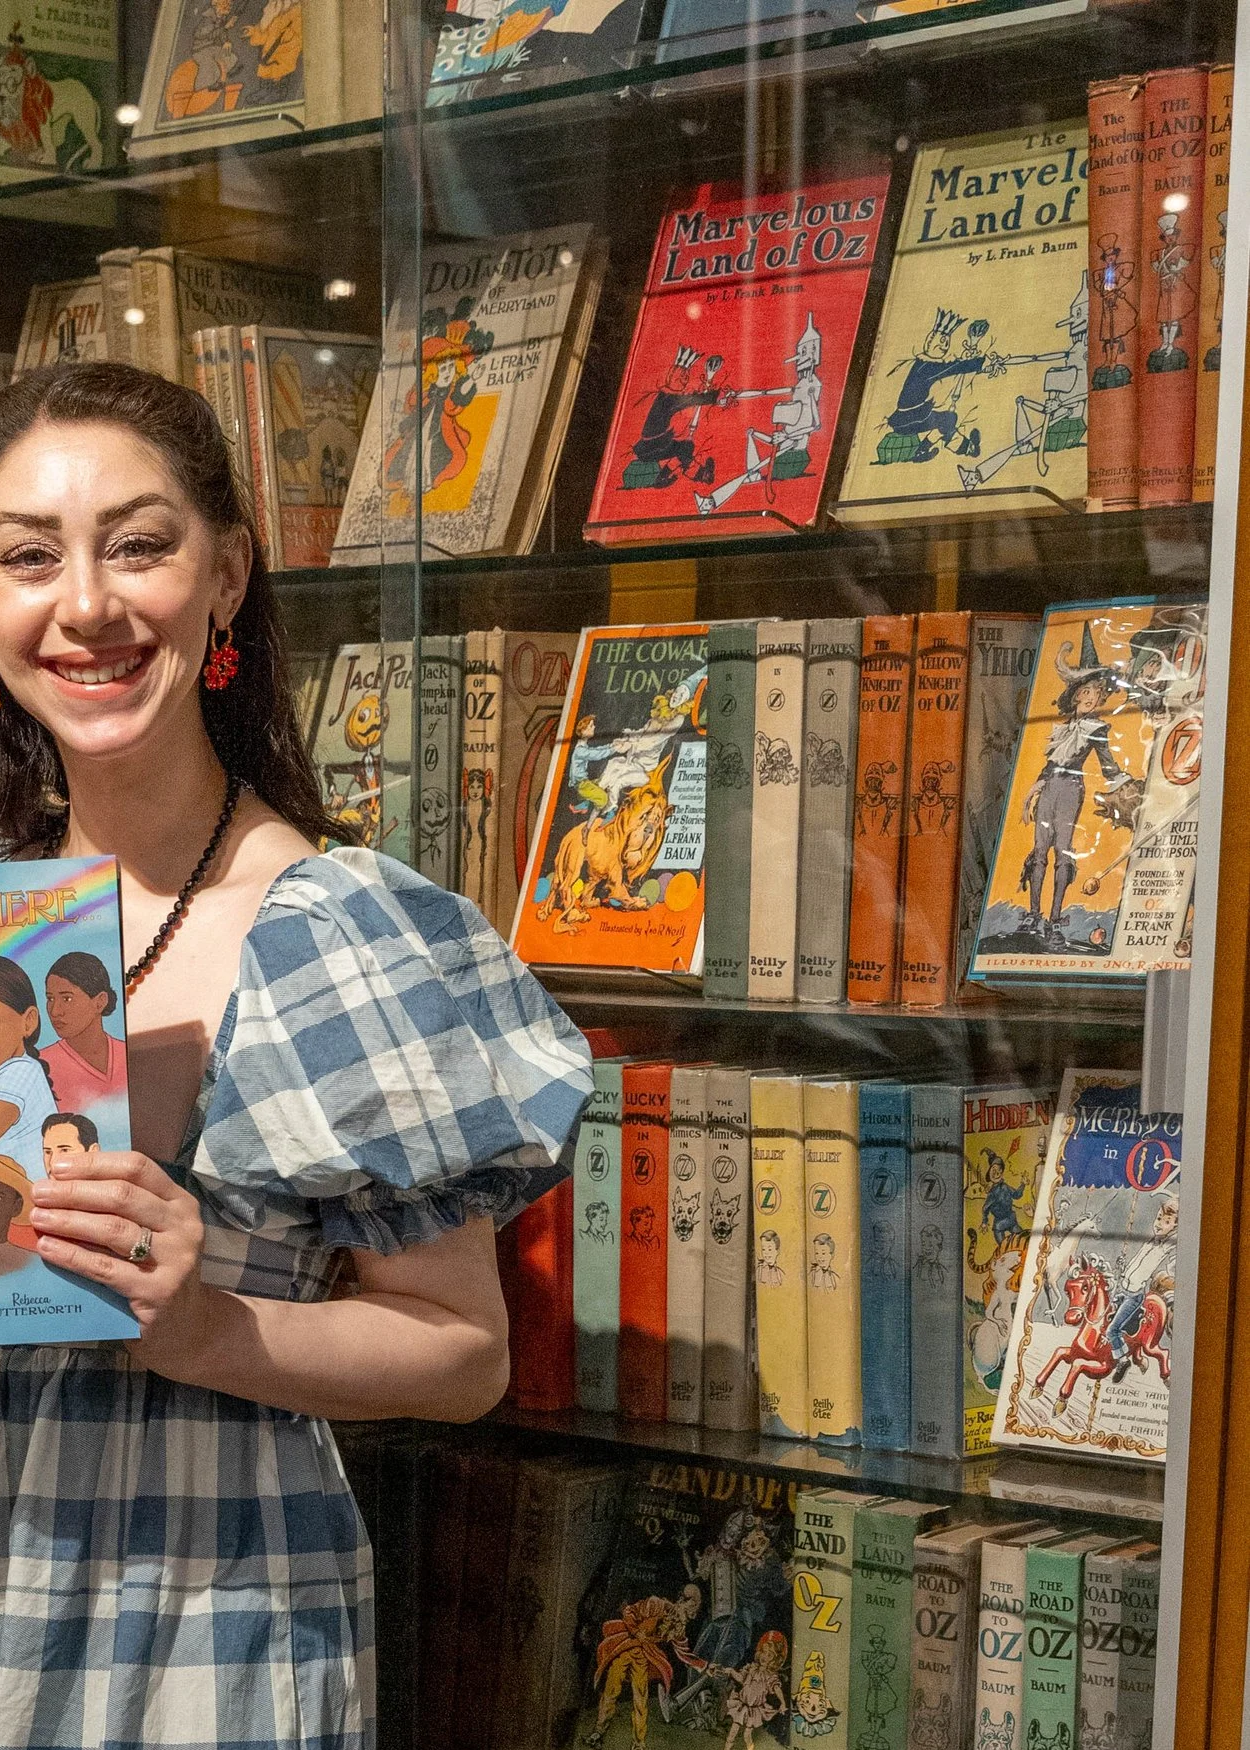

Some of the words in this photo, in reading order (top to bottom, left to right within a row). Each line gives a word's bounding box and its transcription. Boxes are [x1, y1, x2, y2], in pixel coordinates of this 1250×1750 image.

[1160, 98, 1190, 114] THE
[1103, 114, 1124, 126] The
[1149, 114, 1203, 139] LAND
[1023, 131, 1067, 150] The
[1116, 149, 1128, 164] of
[1147, 147, 1166, 162] OF
[1171, 137, 1201, 159] OZ
[1209, 141, 1228, 158] OF
[1098, 182, 1131, 197] Baum
[1154, 174, 1192, 191] BAUM
[669, 195, 876, 248] Marvelous
[917, 194, 1025, 243] Land
[1034, 186, 1081, 226] of
[661, 237, 759, 285] Land
[764, 231, 808, 269] of
[812, 226, 869, 264] Oz
[966, 252, 982, 267] by
[1000, 246, 1035, 260] Frank
[1041, 241, 1078, 254] Baum
[182, 263, 214, 287] THE
[425, 254, 492, 295] DOT
[506, 241, 569, 283] TOT
[488, 286, 506, 300] OF
[706, 292, 718, 305] by
[476, 294, 556, 317] MERRYLAND
[526, 336, 546, 351] BY
[486, 370, 525, 387] BAUM
[595, 641, 633, 664] THE
[758, 642, 802, 656] PIRATES
[810, 642, 855, 656] PIRATES
[464, 659, 498, 675] OZMA
[862, 656, 905, 672] YELLOW
[919, 655, 965, 671] YELLOW
[420, 664, 449, 681] Jack
[604, 664, 666, 694] LION
[667, 668, 690, 685] OF
[773, 667, 782, 676] IN
[826, 667, 836, 676] IN
[473, 678, 485, 688] OF
[861, 676, 903, 691] KNIGHT
[917, 675, 962, 690] KNIGHT
[464, 691, 497, 721] OZ
[862, 700, 877, 712] OF
[878, 694, 902, 713] OZ
[917, 698, 934, 712] OF
[935, 692, 960, 712] OZ
[428, 719, 442, 738] of
[664, 846, 697, 860] BAUM
[1132, 888, 1149, 896] THE
[1165, 911, 1177, 919] BY
[1125, 934, 1168, 946] BAUM
[750, 955, 787, 969] Reilly
[799, 954, 837, 968] Reilly
[903, 960, 942, 974] Reilly
[986, 958, 1077, 968] ILLUSTRATED
[1080, 960, 1096, 968] BY
[760, 967, 783, 978] Lee
[808, 967, 833, 978] Lee
[912, 973, 938, 984] Lee
[625, 1092, 667, 1107] LUCKY
[676, 1098, 691, 1106] THE
[716, 1099, 734, 1107] THE
[911, 1113, 950, 1128] HIDDEN
[964, 1098, 1050, 1134] HIDDEN
[592, 1128, 604, 1138] IN
[637, 1131, 649, 1140] IN
[679, 1141, 689, 1149] IN
[719, 1143, 729, 1151] IN
[1102, 1144, 1119, 1160] in
[926, 1155, 936, 1168] of
[12, 1292, 52, 1307] Rebecca
[1085, 1383, 1094, 1396] by
[813, 1398, 835, 1413] Reilly
[803, 1511, 834, 1529] THE
[793, 1528, 847, 1556] LAND
[861, 1543, 905, 1566] LAND
[805, 1556, 826, 1571] OF
[917, 1573, 961, 1596] ROAD
[1087, 1571, 1113, 1584] THE
[989, 1580, 1014, 1594] THE
[1038, 1579, 1064, 1592] THE
[792, 1571, 844, 1634] OZ
[865, 1593, 896, 1609] BAUM
[928, 1594, 945, 1607] TO
[980, 1592, 1025, 1615] ROAD
[1029, 1591, 1074, 1613] ROAD
[1042, 1613, 1059, 1625] TO
[1090, 1605, 1108, 1618] TO
[915, 1607, 959, 1642] OZ
[992, 1614, 1009, 1627] TO
[1081, 1618, 1122, 1653] OZ
[979, 1627, 1024, 1662] OZ
[1027, 1626, 1074, 1661] OZ
[917, 1659, 952, 1675] BAUM
[981, 1679, 1016, 1696] BAUM
[1030, 1679, 1067, 1695] BAUM
